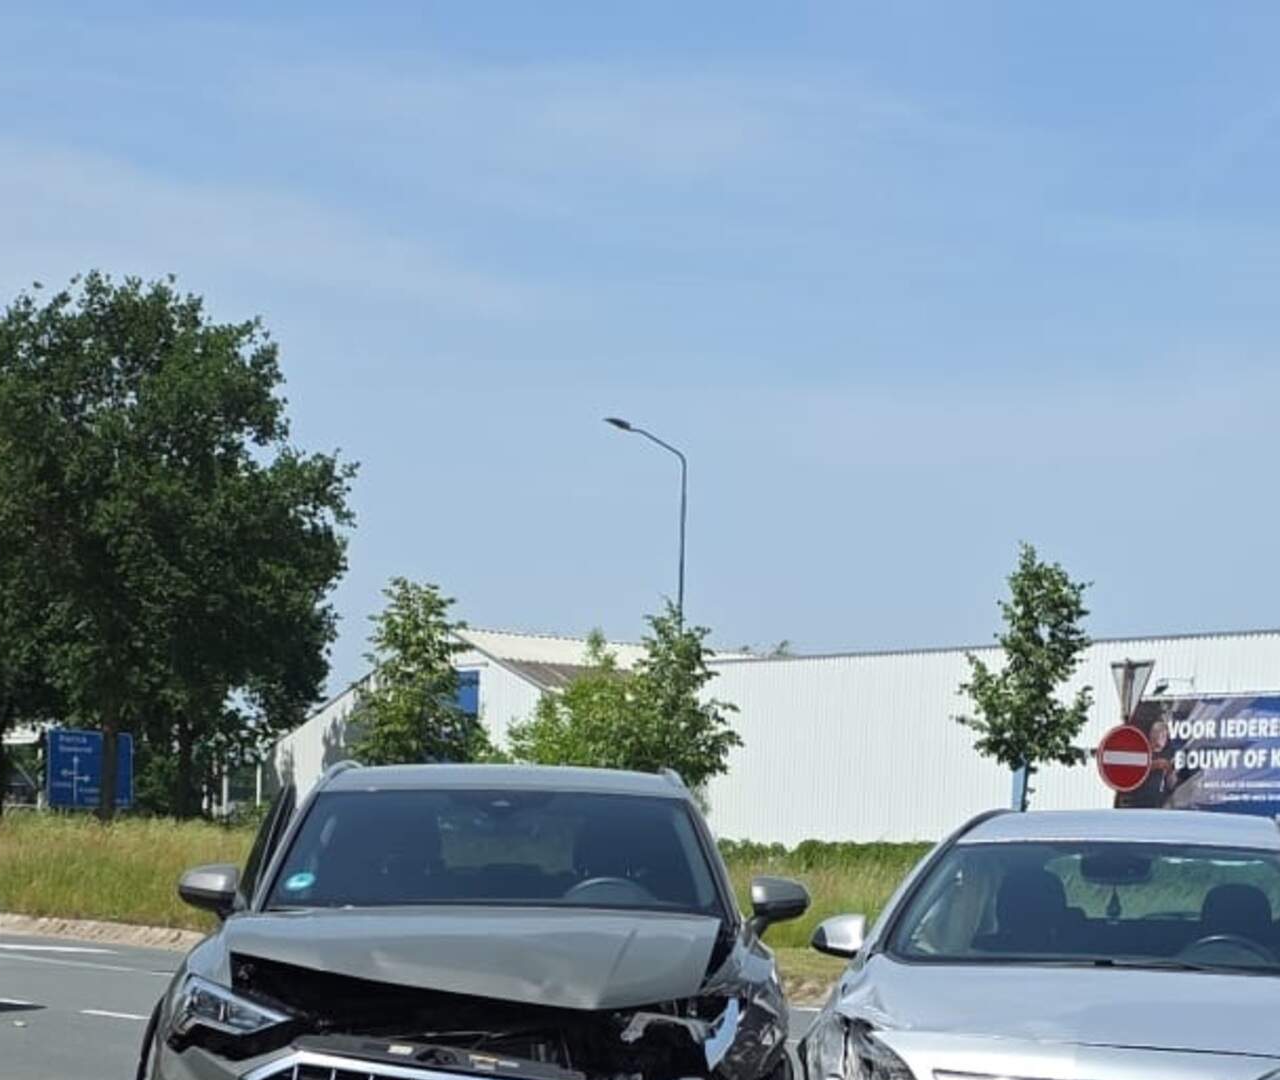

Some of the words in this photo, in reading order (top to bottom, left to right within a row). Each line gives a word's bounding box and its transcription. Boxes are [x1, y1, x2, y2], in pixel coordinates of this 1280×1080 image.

[1168, 720, 1216, 740] VOOR
[1174, 750, 1237, 770] BOUWT
[1243, 750, 1268, 769] OF
